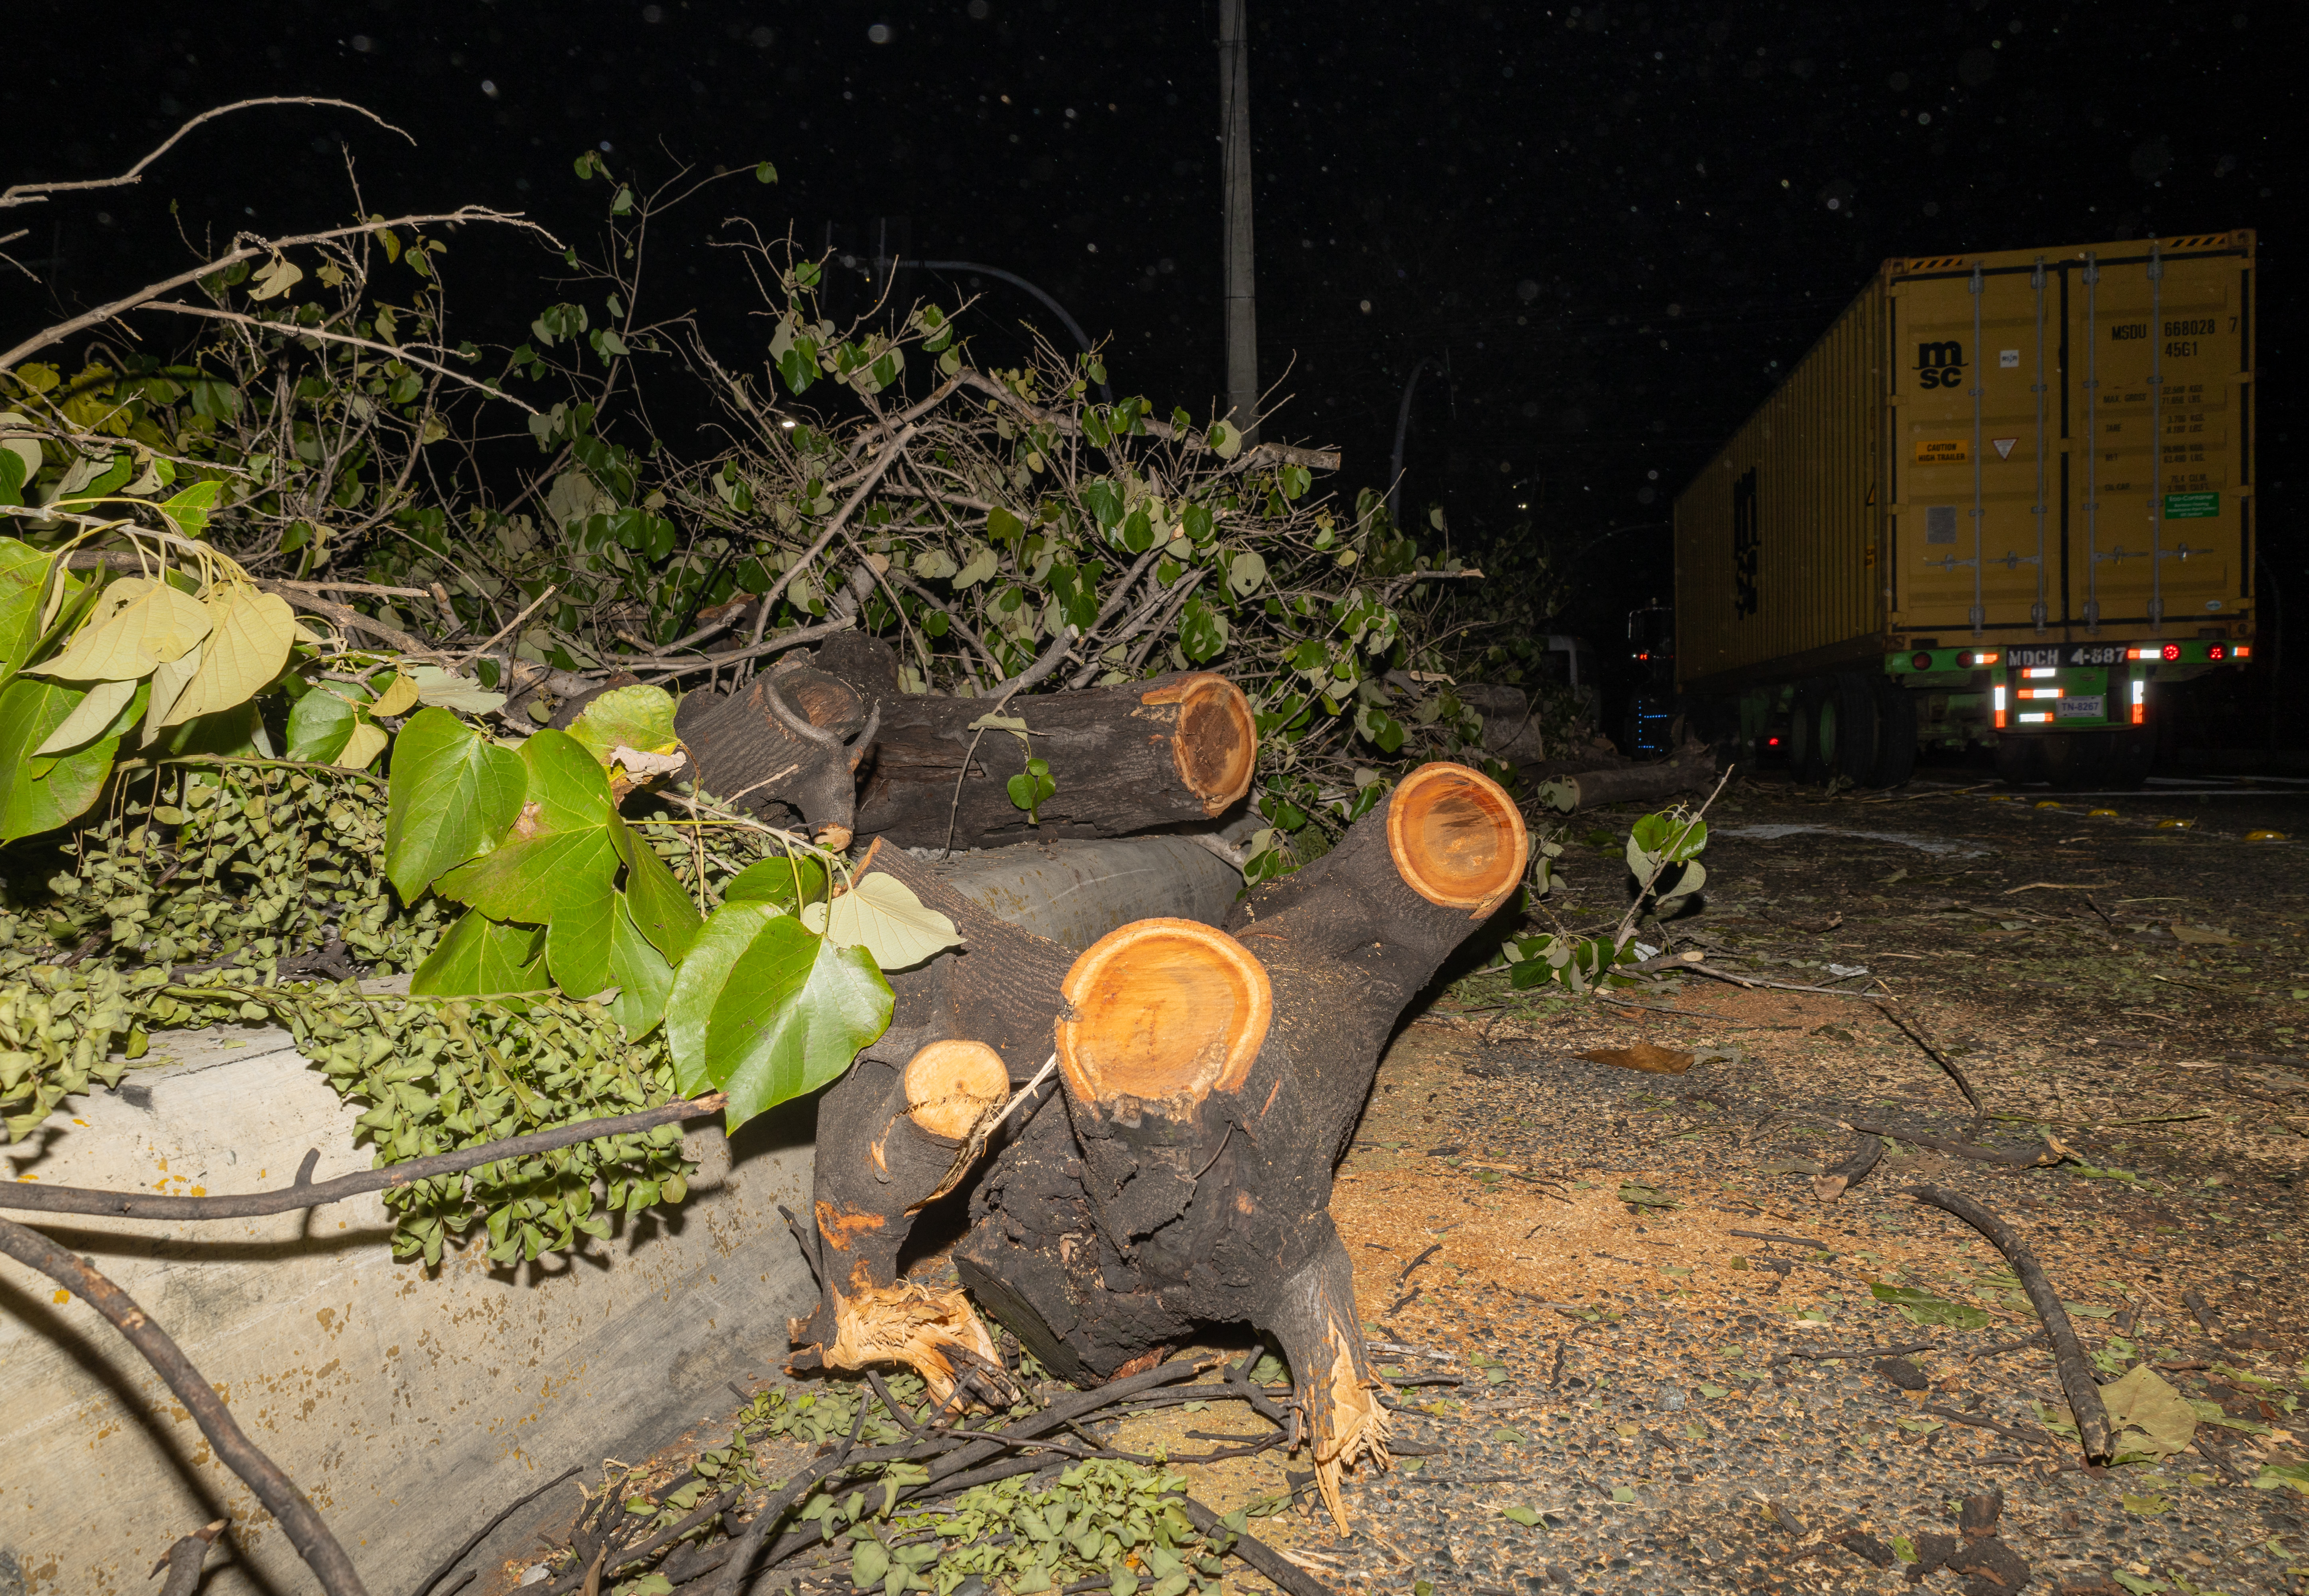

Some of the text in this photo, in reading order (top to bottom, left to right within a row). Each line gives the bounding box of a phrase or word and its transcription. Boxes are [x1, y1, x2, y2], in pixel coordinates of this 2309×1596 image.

[2111, 316, 2238, 340] MSDU 668028 7
[2165, 342, 2197, 357] 45G1
[2125, 393, 2147, 402] GROSS
[2106, 424, 2121, 432] TARE
[1927, 443, 1957, 452] CAUTION
[2008, 649, 2059, 667] MDCH
[2062, 702, 2099, 711] TN-8267
